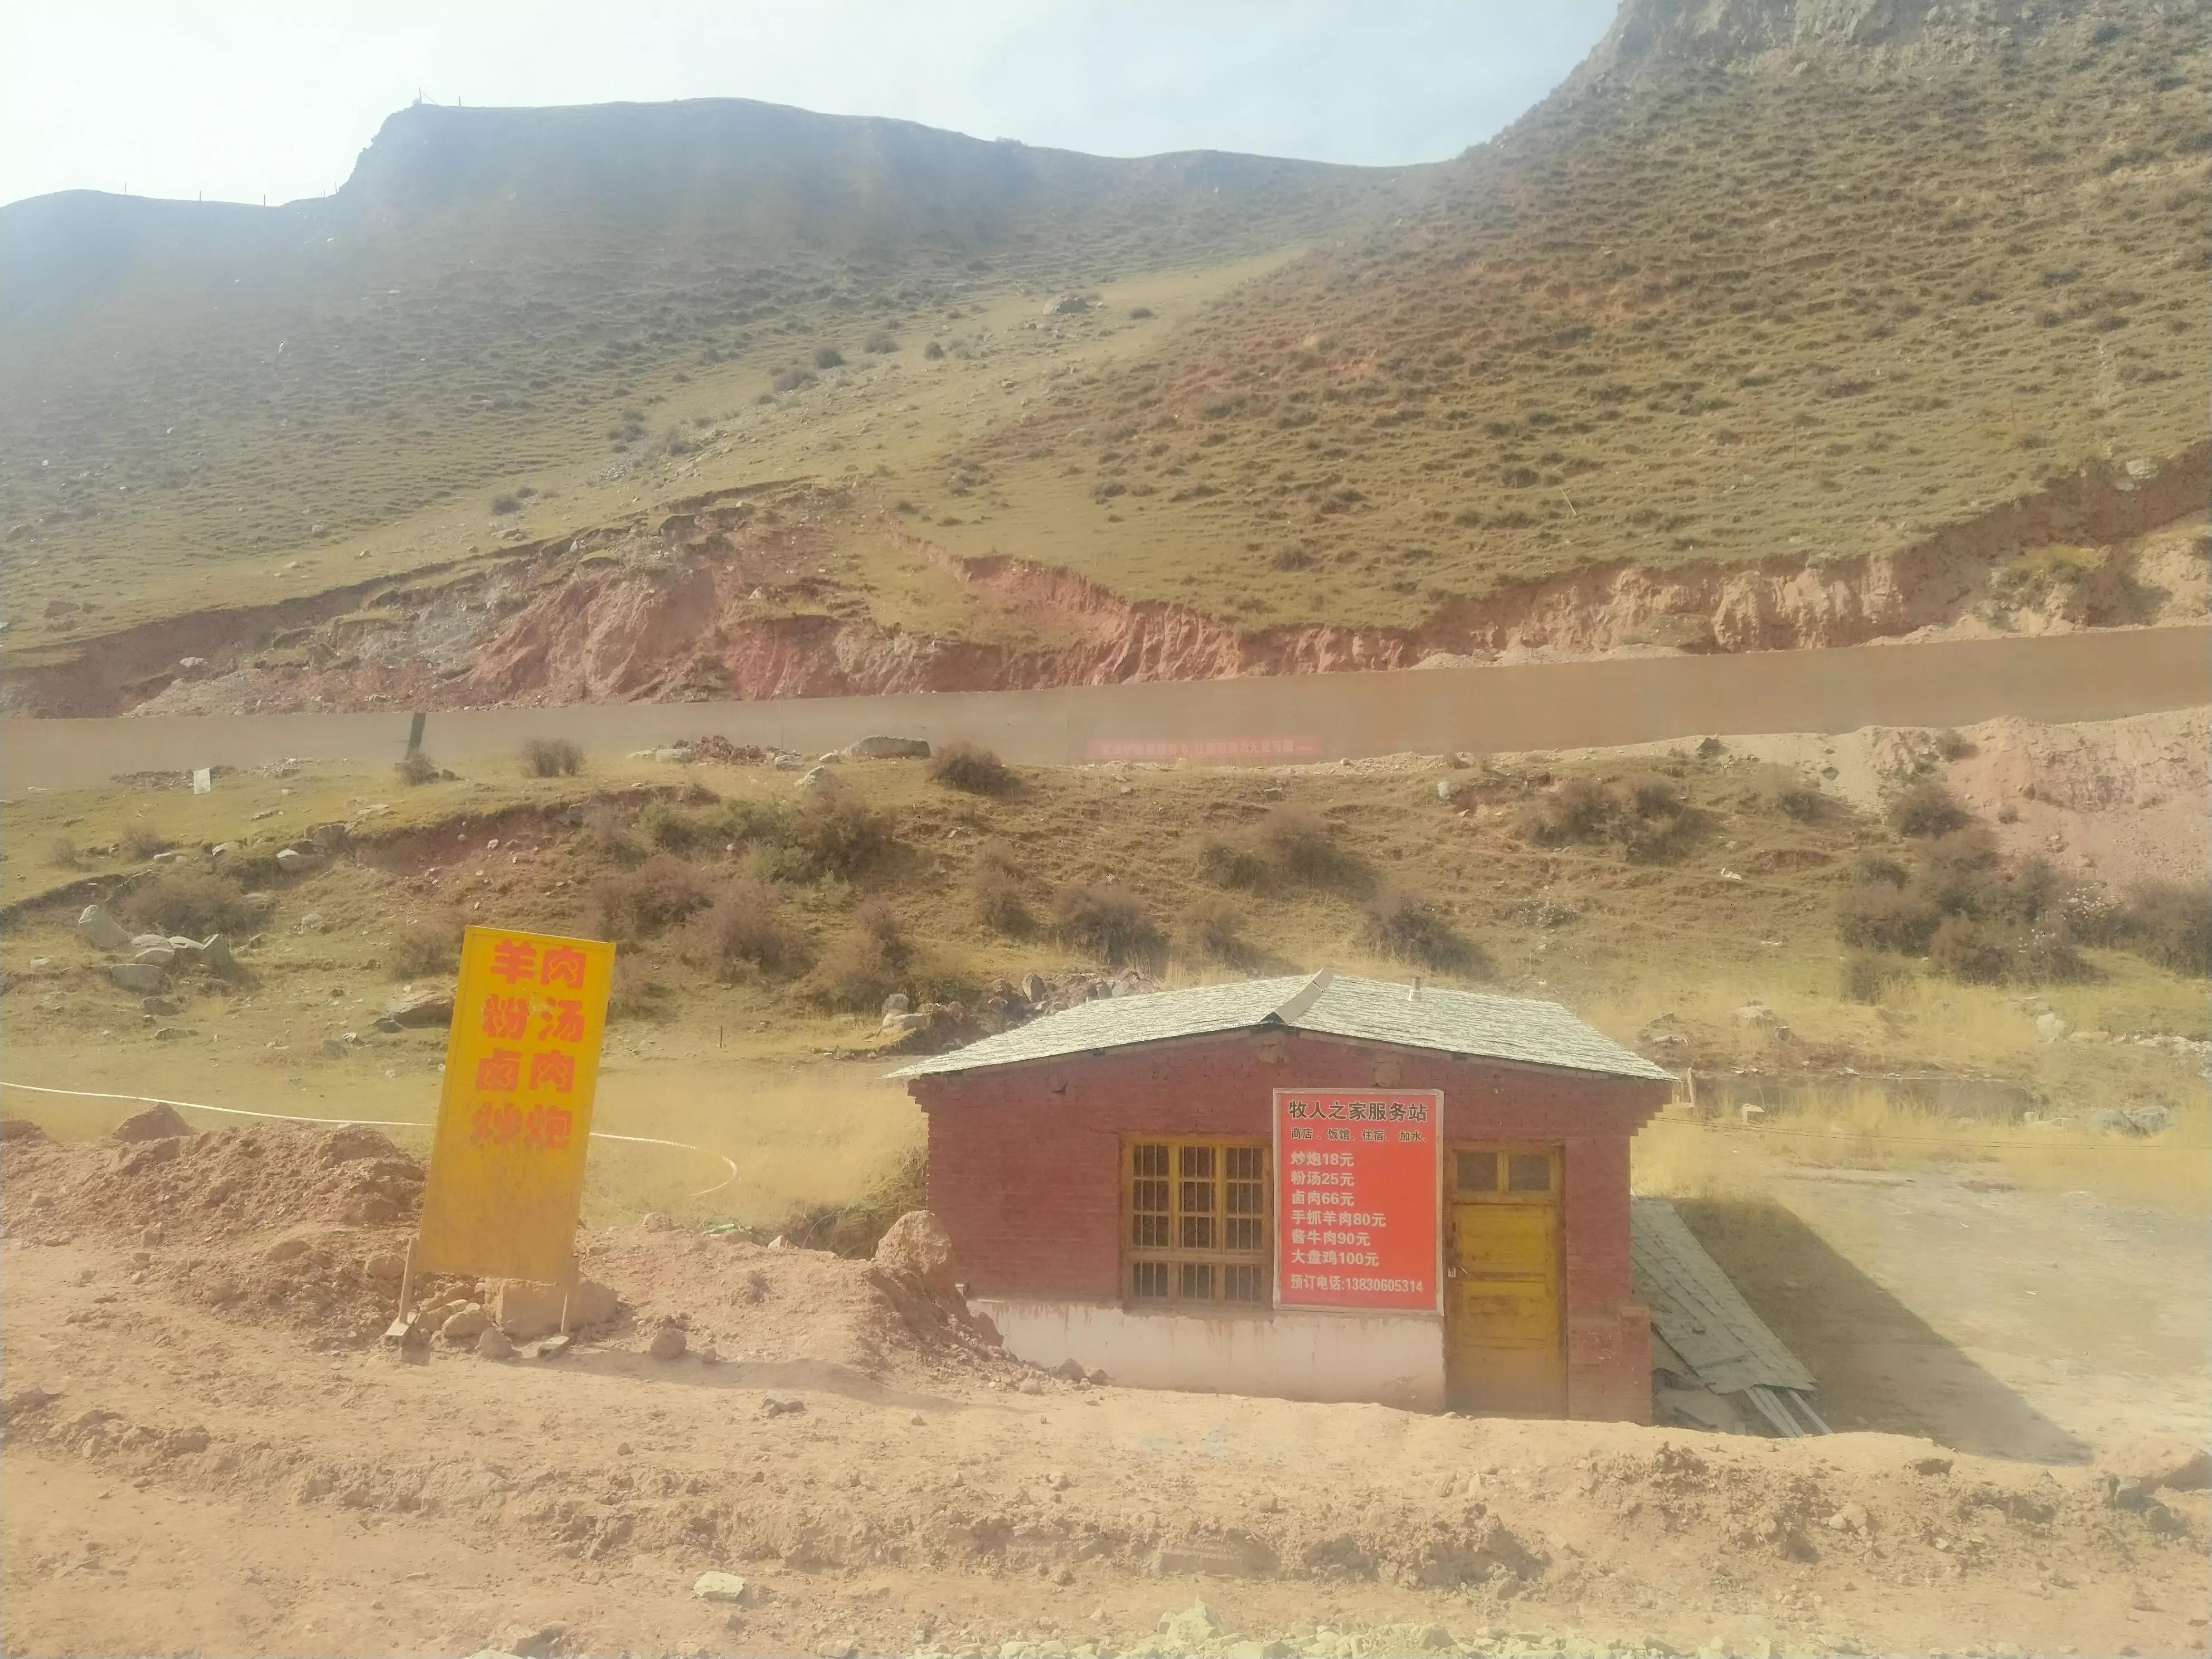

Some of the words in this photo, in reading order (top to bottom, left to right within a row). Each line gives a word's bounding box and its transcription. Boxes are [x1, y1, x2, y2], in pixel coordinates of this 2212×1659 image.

[489, 938, 587, 989] 羊肉
[481, 993, 586, 1043] 粉汤
[476, 1048, 576, 1093] 卤肉
[1288, 1100, 1428, 1122] 牧人之家服务站
[470, 1100, 573, 1149] 炒炮
[1291, 1151, 1355, 1167] 炒炮18元
[1291, 1170, 1355, 1187] 粉汤25元
[1292, 1190, 1355, 1206] 卤肉66元
[1291, 1210, 1386, 1227] 手抓羊肉80元
[1291, 1229, 1371, 1246] 酱牛肉90元
[1291, 1249, 1380, 1267] 大盘鸡100元
